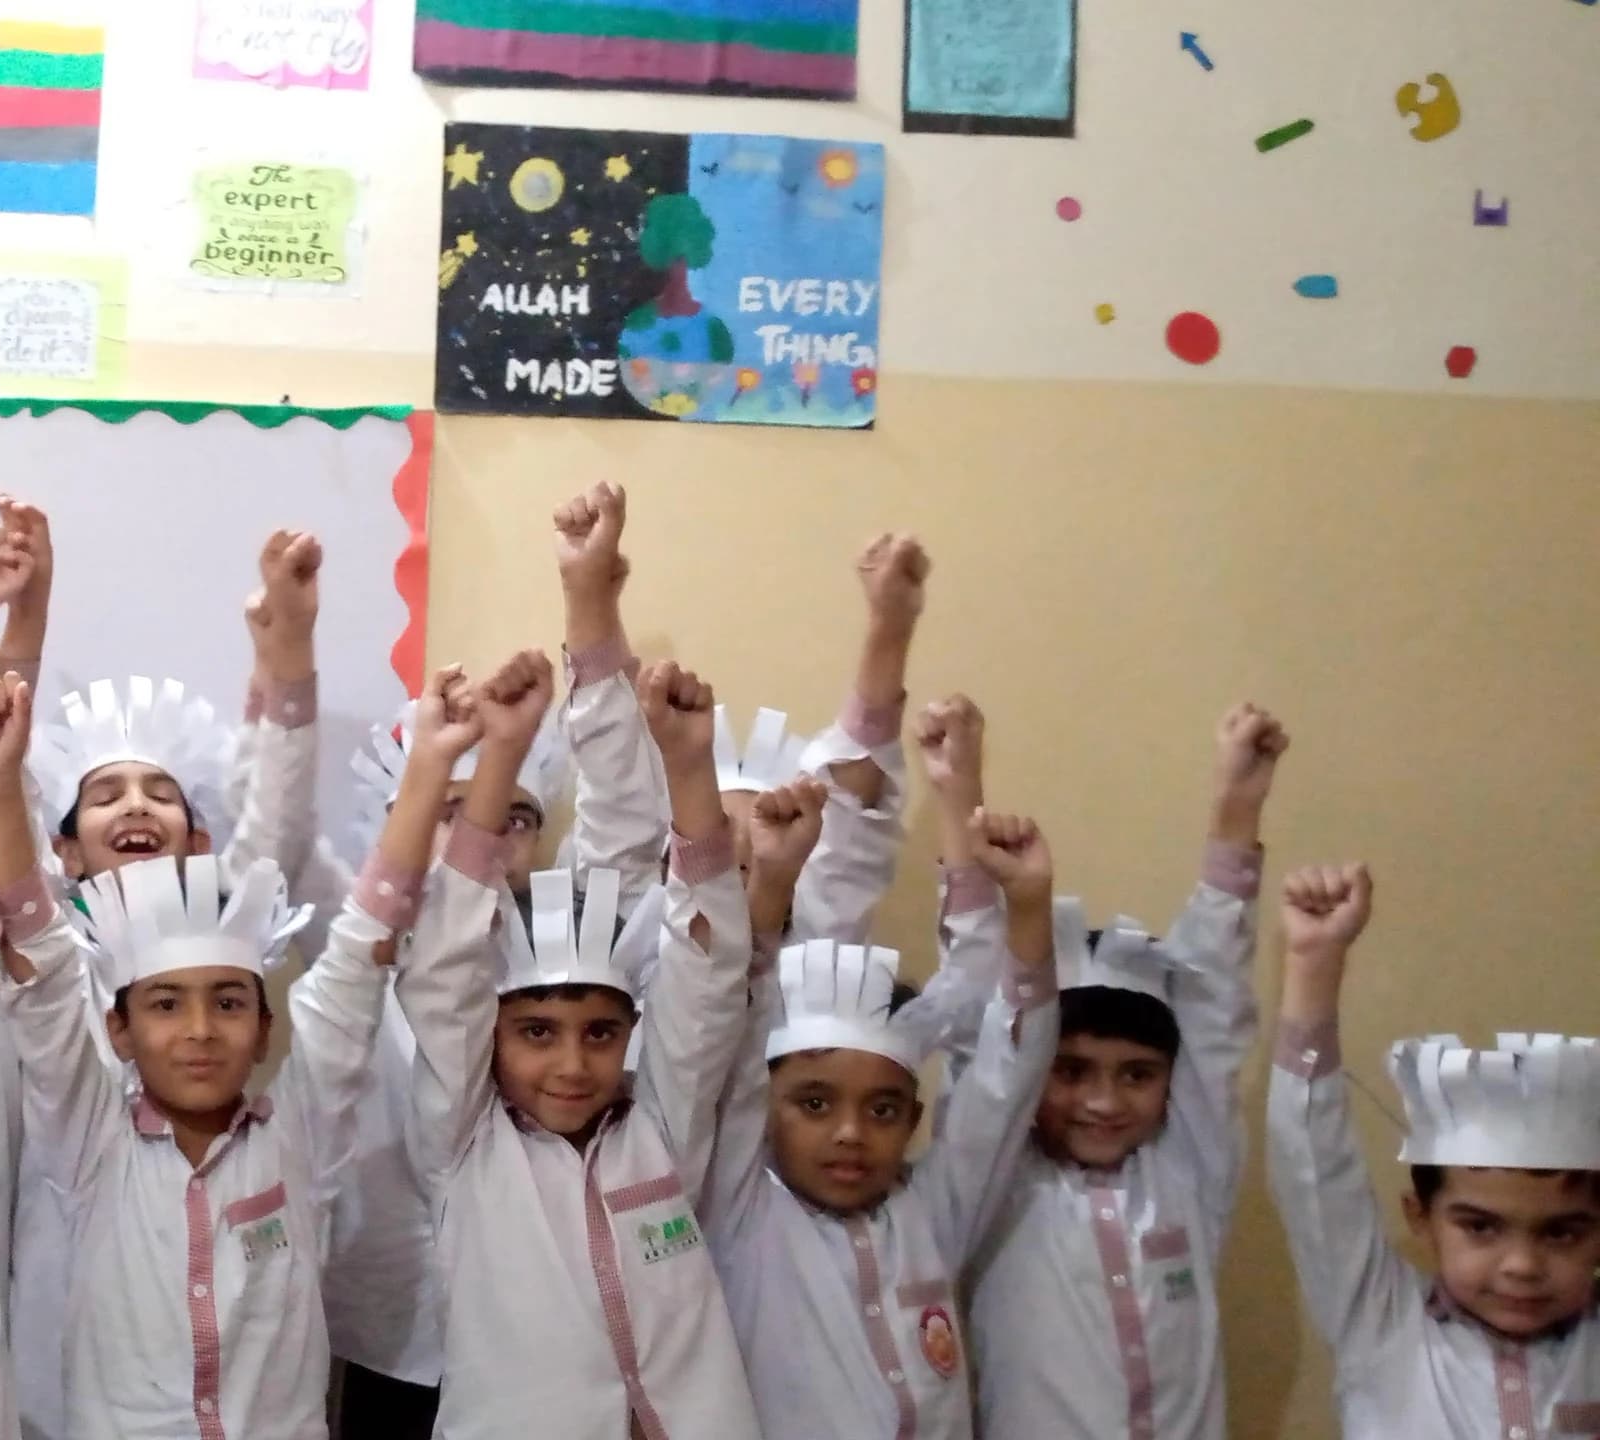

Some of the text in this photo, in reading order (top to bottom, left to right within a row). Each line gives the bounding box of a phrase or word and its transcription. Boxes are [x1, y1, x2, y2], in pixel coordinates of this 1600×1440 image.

[249, 164, 294, 186] The
[224, 191, 319, 212] expert
[204, 241, 335, 267] beginner
[478, 282, 591, 316] ALLAH
[738, 276, 878, 317] EVERY
[505, 357, 618, 397] MADE
